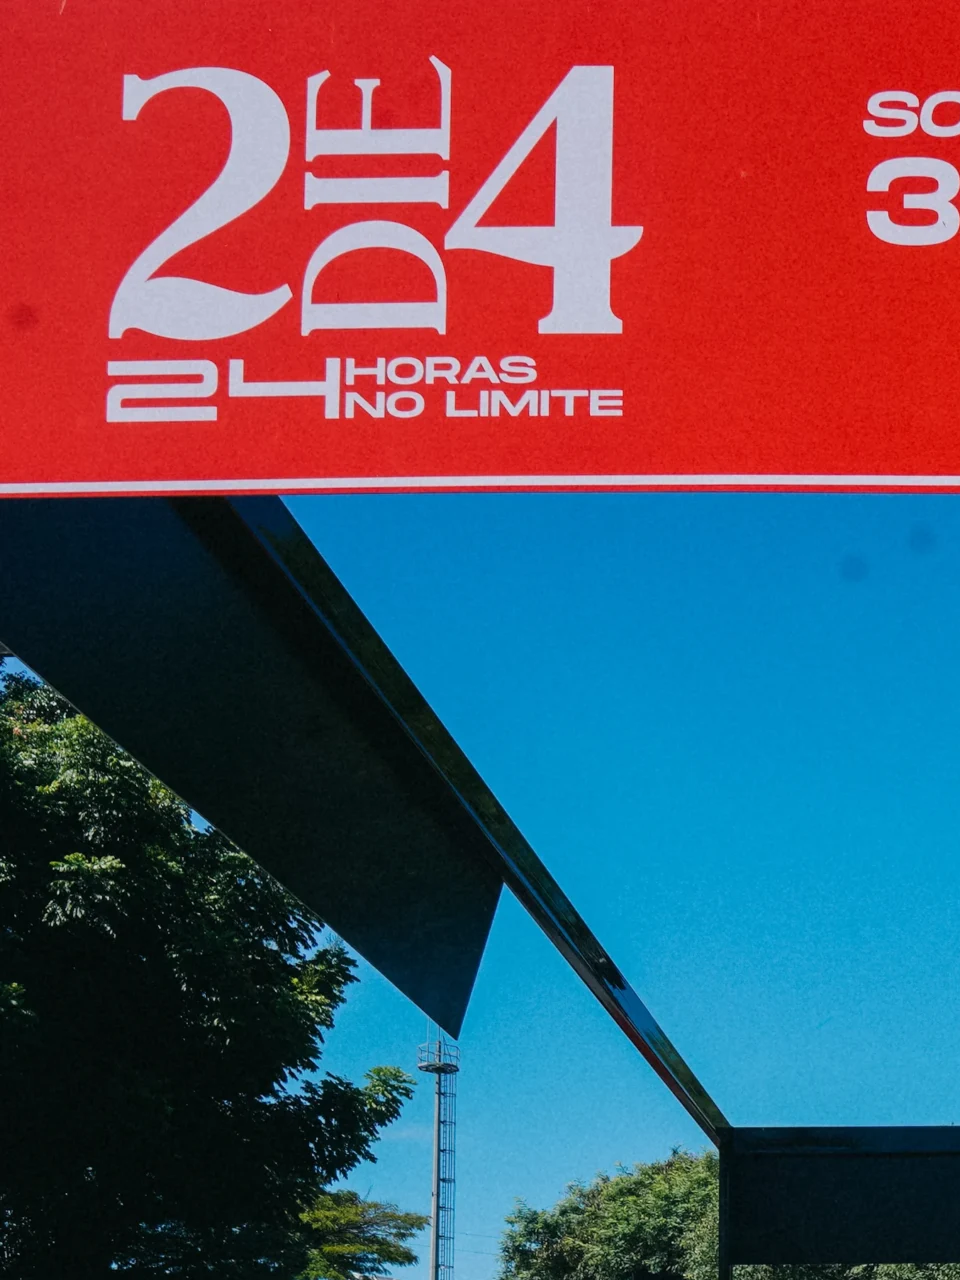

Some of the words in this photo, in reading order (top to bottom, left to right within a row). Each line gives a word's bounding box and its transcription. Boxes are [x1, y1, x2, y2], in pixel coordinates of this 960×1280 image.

[109, 67, 292, 340] 2
[301, 55, 453, 336] DIE
[443, 65, 644, 334] 4
[107, 357, 341, 422] 24
[345, 355, 537, 385] HORAS
[345, 390, 425, 419] NO
[445, 389, 624, 417] LIMITE
